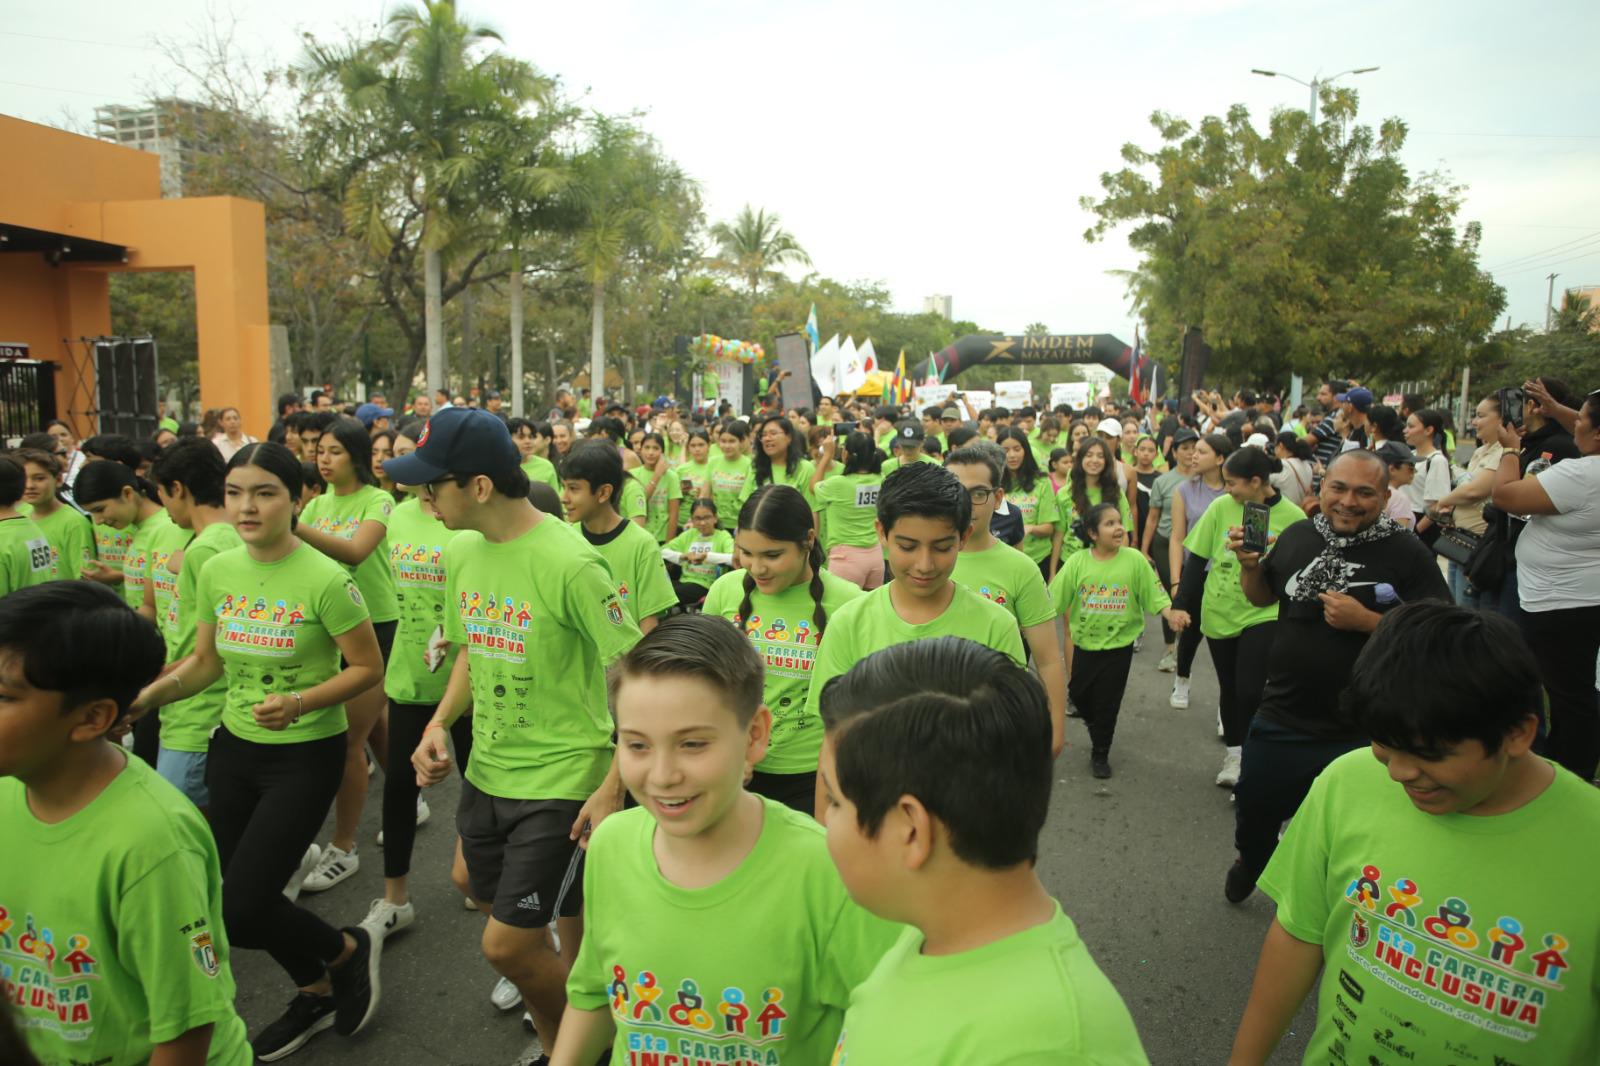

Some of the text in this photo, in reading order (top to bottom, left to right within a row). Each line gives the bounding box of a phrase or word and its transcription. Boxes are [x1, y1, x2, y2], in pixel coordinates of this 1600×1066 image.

[1022, 336, 1094, 348] IMDEM
[248, 625, 295, 637] CARRERA
[486, 627, 525, 642] ARRERA
[223, 632, 295, 648] INCLUSIVA
[467, 633, 525, 654] INUSVA
[767, 655, 815, 671] LUSIV
[1377, 924, 1546, 1007] 5ta CARRERA
[1375, 940, 1539, 1026] INCLUSIVA
[628, 1033, 779, 1066] 5ta CARRERA
